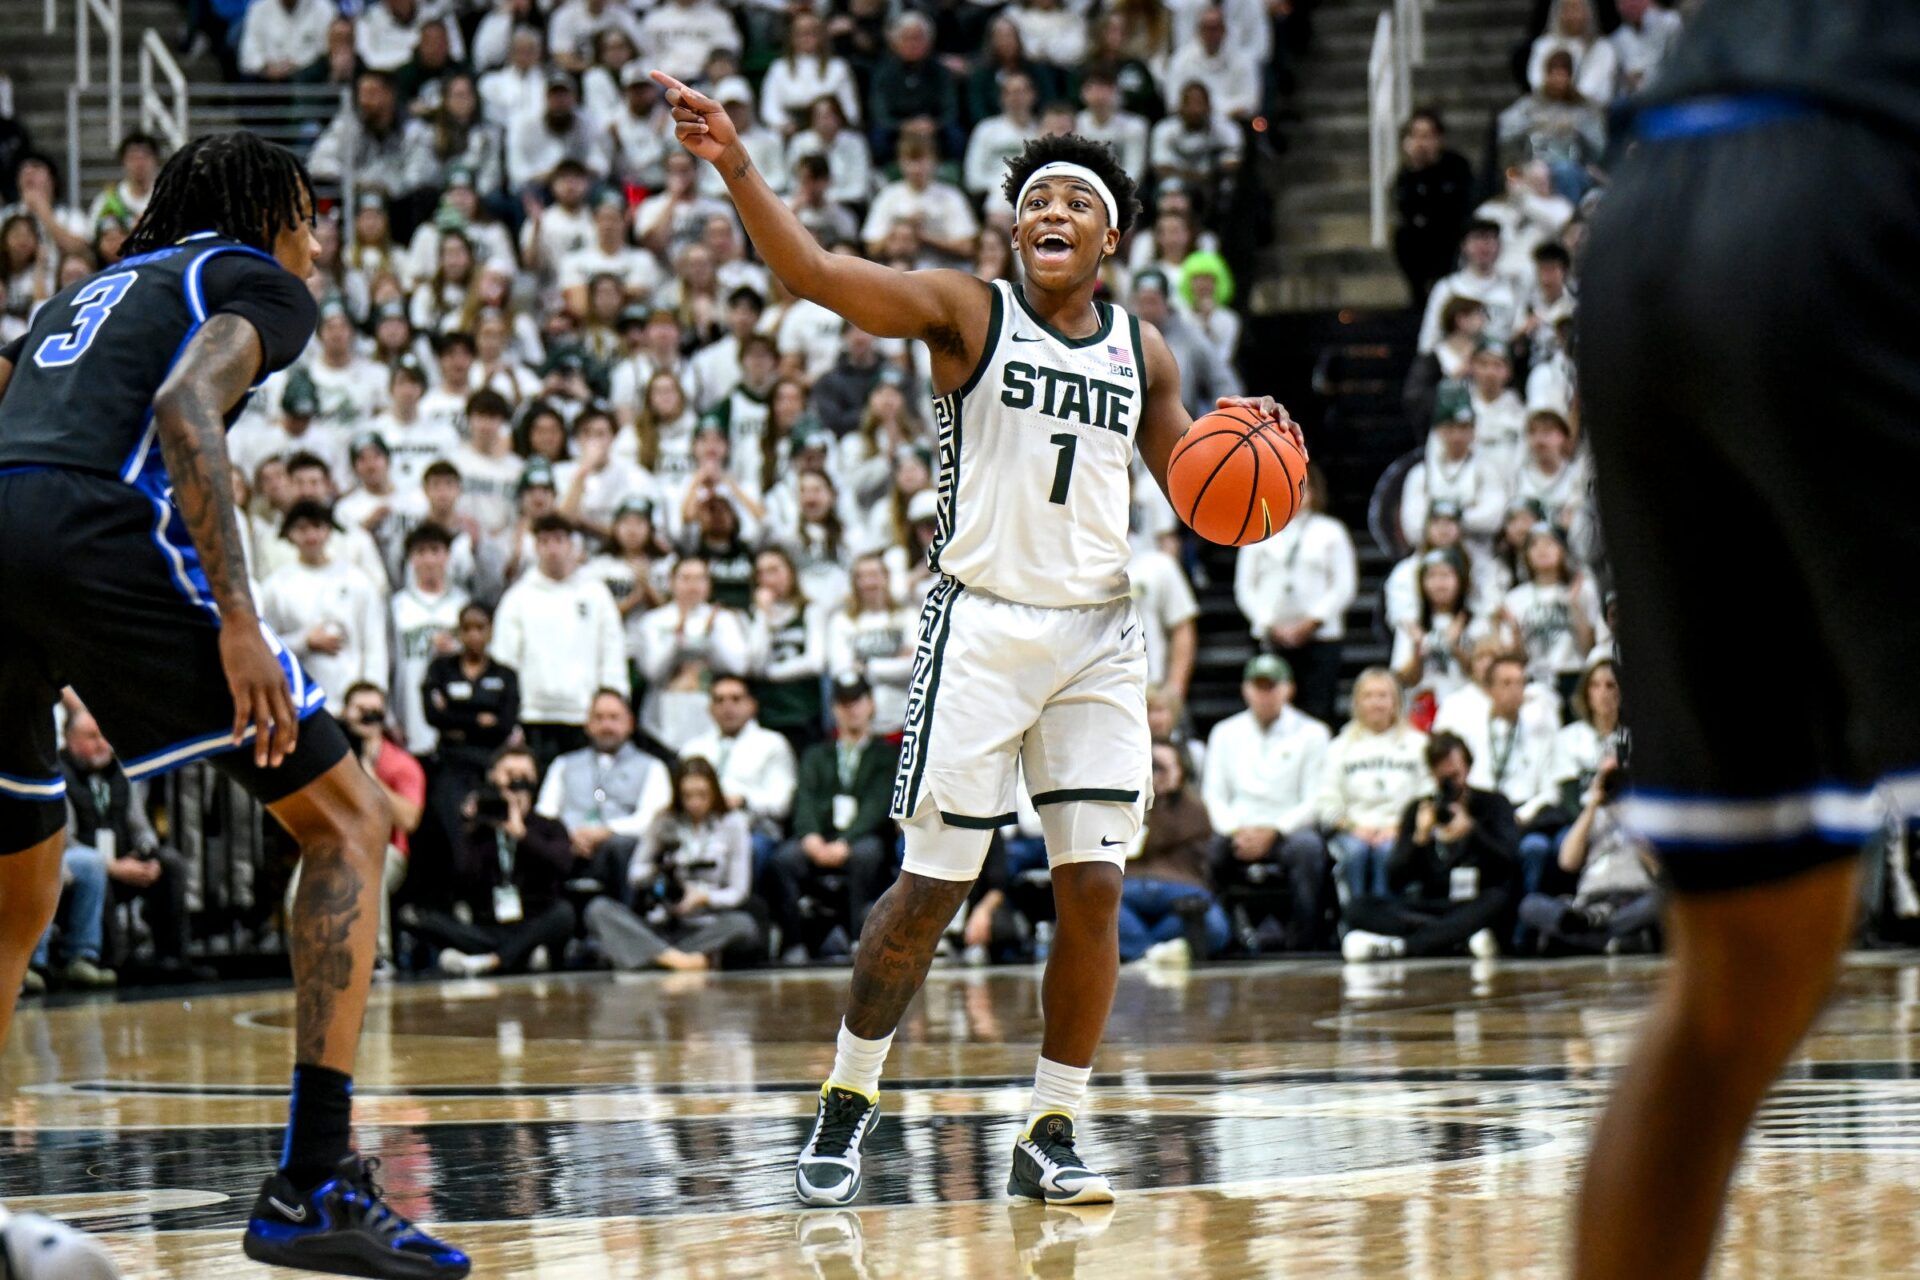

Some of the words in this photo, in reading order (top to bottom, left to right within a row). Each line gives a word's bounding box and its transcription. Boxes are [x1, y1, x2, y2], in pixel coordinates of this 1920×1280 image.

[33, 270, 139, 368] 3
[1001, 361, 1134, 437] STATE
[1049, 433, 1078, 505] 1
